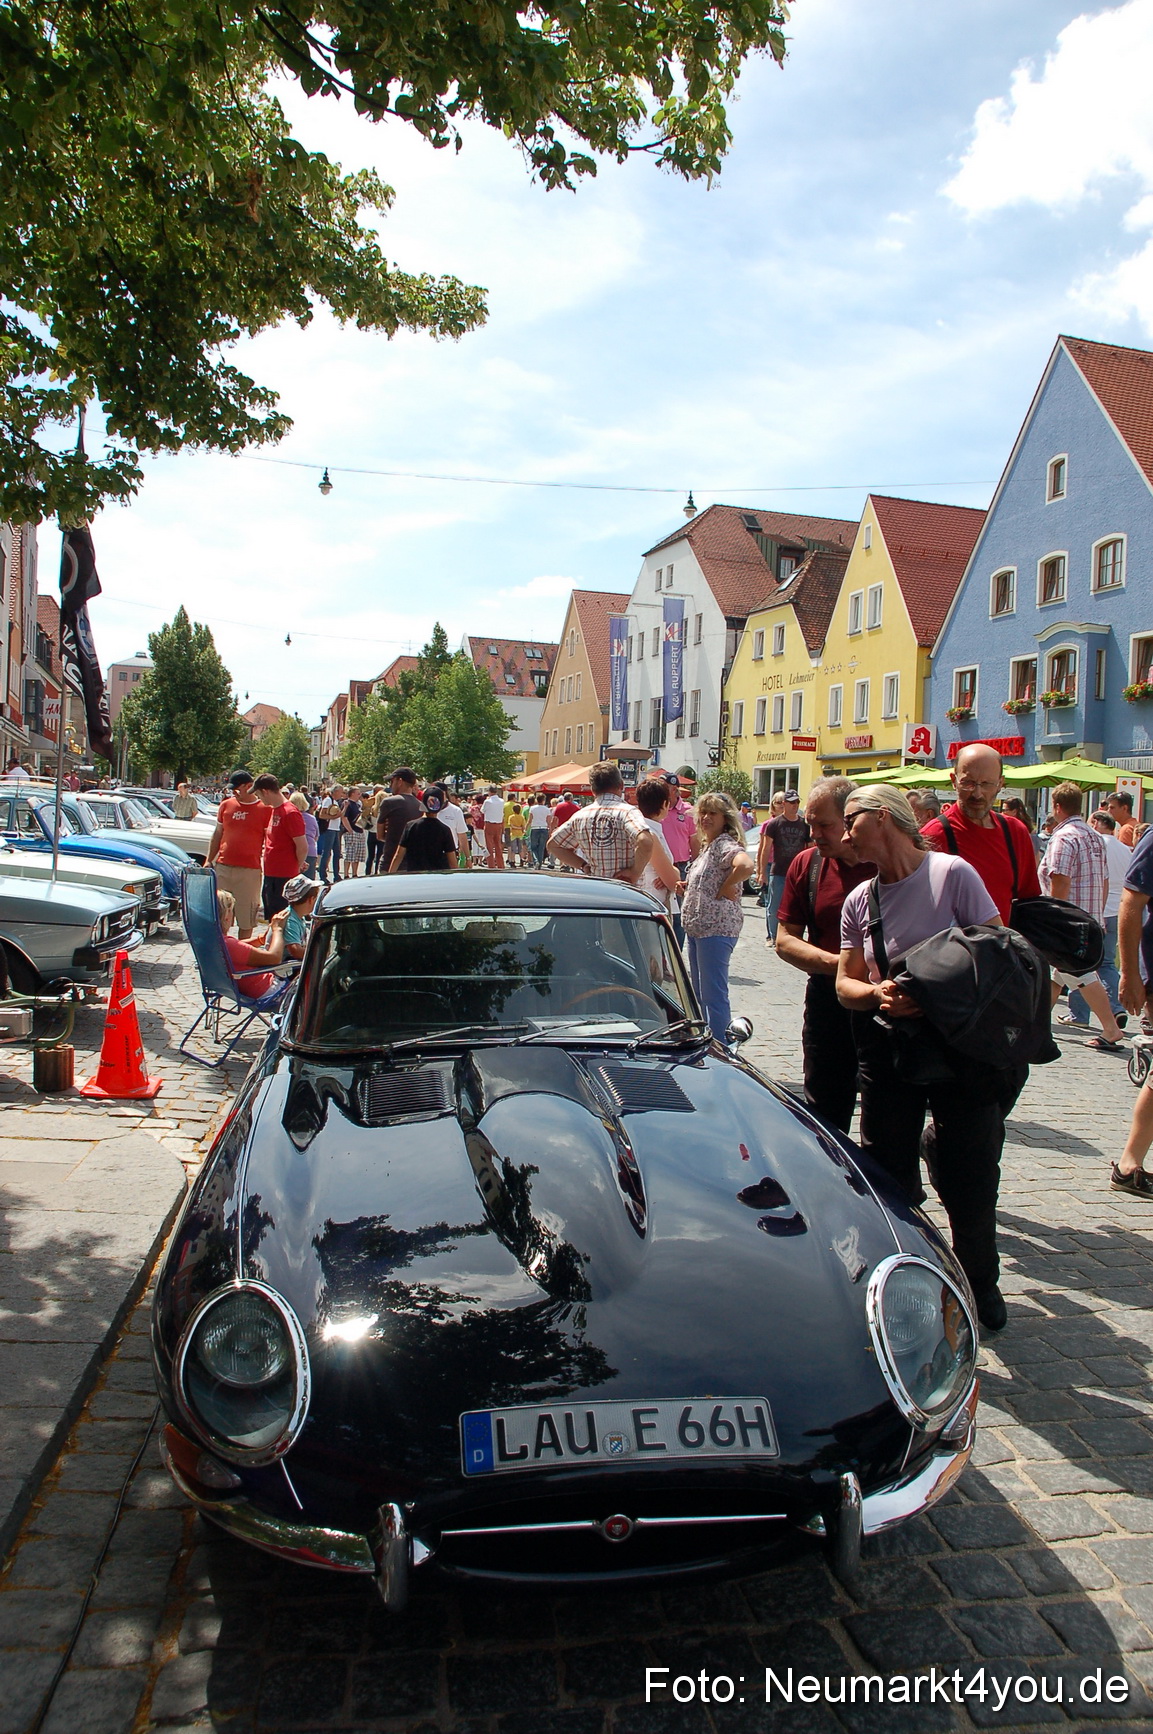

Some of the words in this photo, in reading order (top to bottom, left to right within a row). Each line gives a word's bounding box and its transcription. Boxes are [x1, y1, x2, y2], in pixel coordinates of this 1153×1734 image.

[671, 645, 679, 689] RUPPERT
[762, 674, 784, 691] HOTEL
[789, 671, 815, 686] Lehmeier
[756, 750, 788, 762] Restaurant
[495, 1408, 600, 1462] LAU
[631, 1407, 667, 1452] E
[677, 1404, 771, 1450] 66H
[473, 1449, 484, 1463] D
